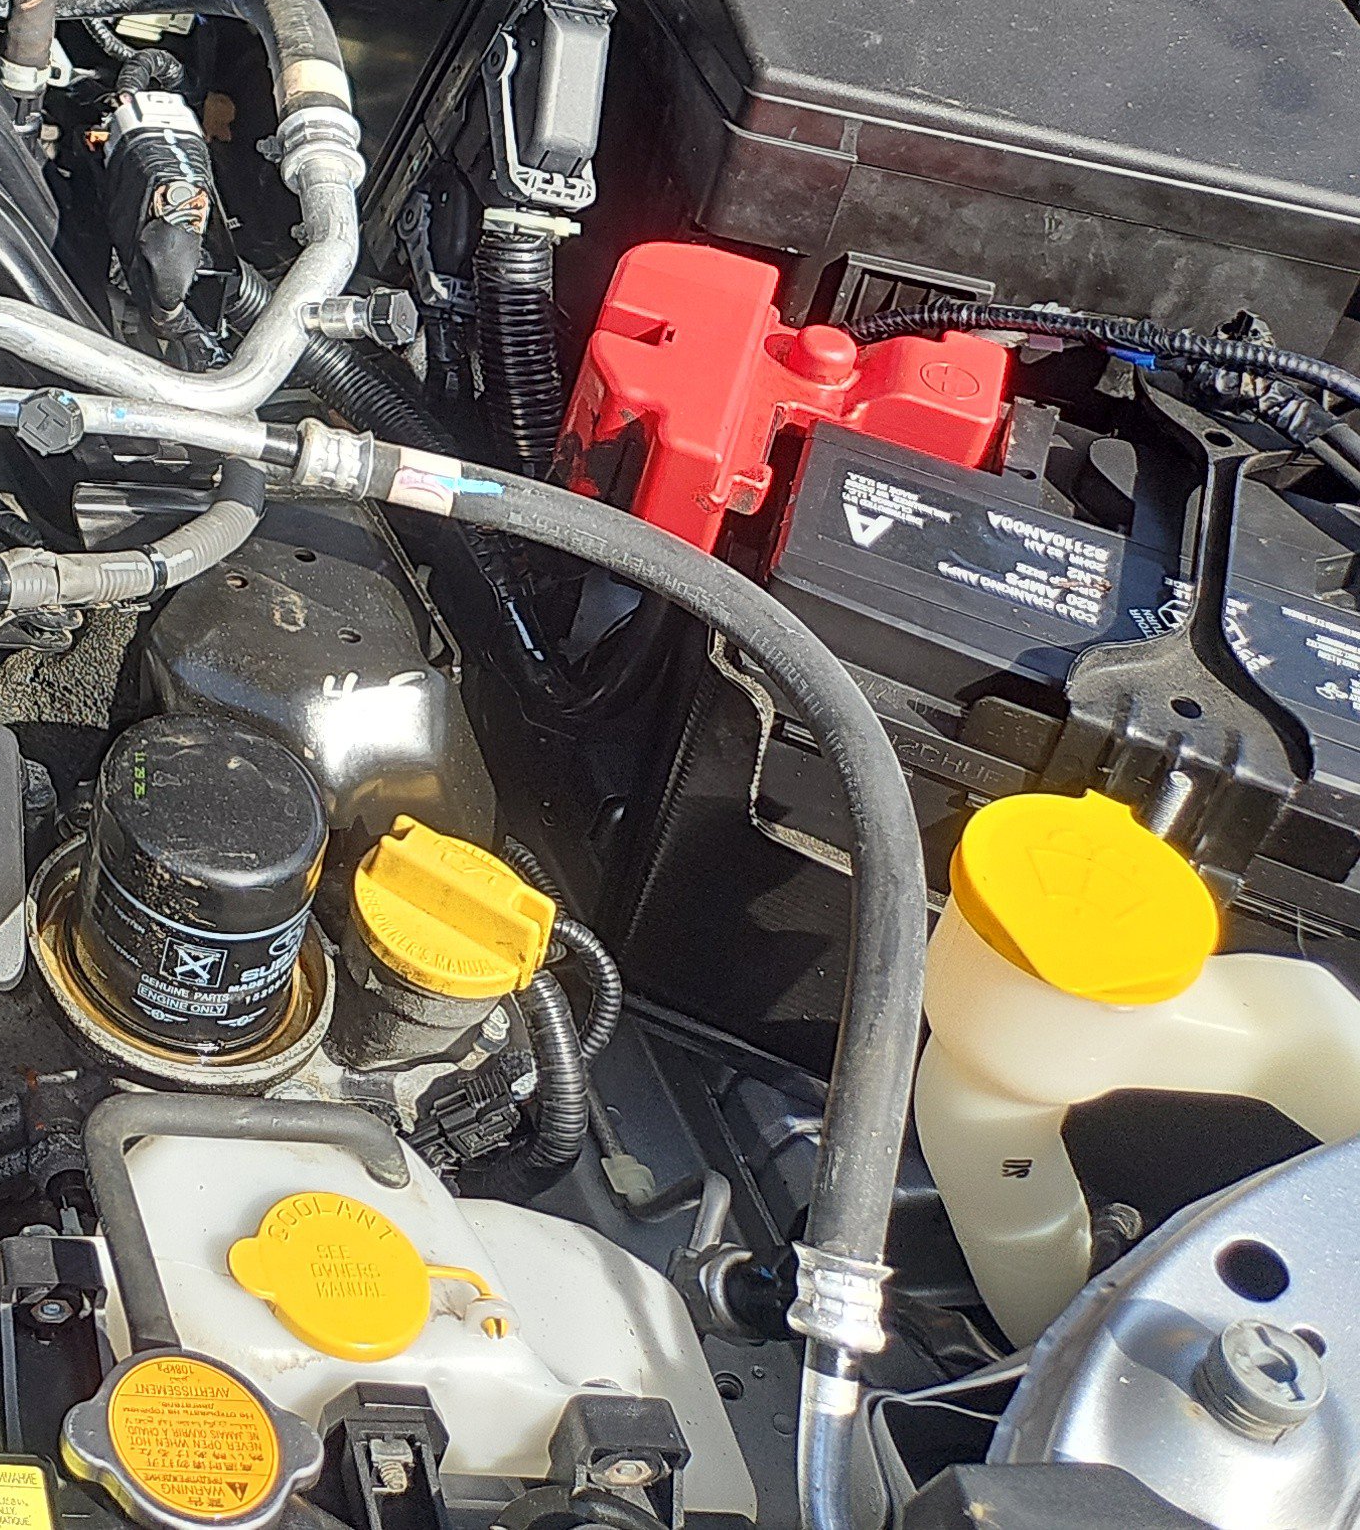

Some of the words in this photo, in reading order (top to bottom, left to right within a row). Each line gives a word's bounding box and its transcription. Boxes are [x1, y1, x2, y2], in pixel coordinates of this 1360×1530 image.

[140, 973, 189, 999] GENUINE
[194, 991, 230, 1004] PARTS
[140, 987, 188, 1011] ENGINE
[190, 1002, 226, 1015] ONLY
[268, 1197, 397, 1242] COOLANT
[317, 1245, 351, 1260] SEE
[311, 1263, 381, 1279] OWNERS
[316, 1282, 387, 1299] MANUAL
[157, 1364, 193, 1374] 108kPa
[135, 1384, 229, 1398] AVERTISSEMENT
[173, 1430, 206, 1438] OUVRIR
[211, 1431, 243, 1440] JAMAIS
[247, 1432, 259, 1440] NE
[127, 1436, 151, 1446] HOT.
[156, 1438, 188, 1448] WHEN
[193, 1440, 222, 1450] OPEN
[226, 1442, 262, 1452] NEVER
[160, 1484, 225, 1497] WARNING
